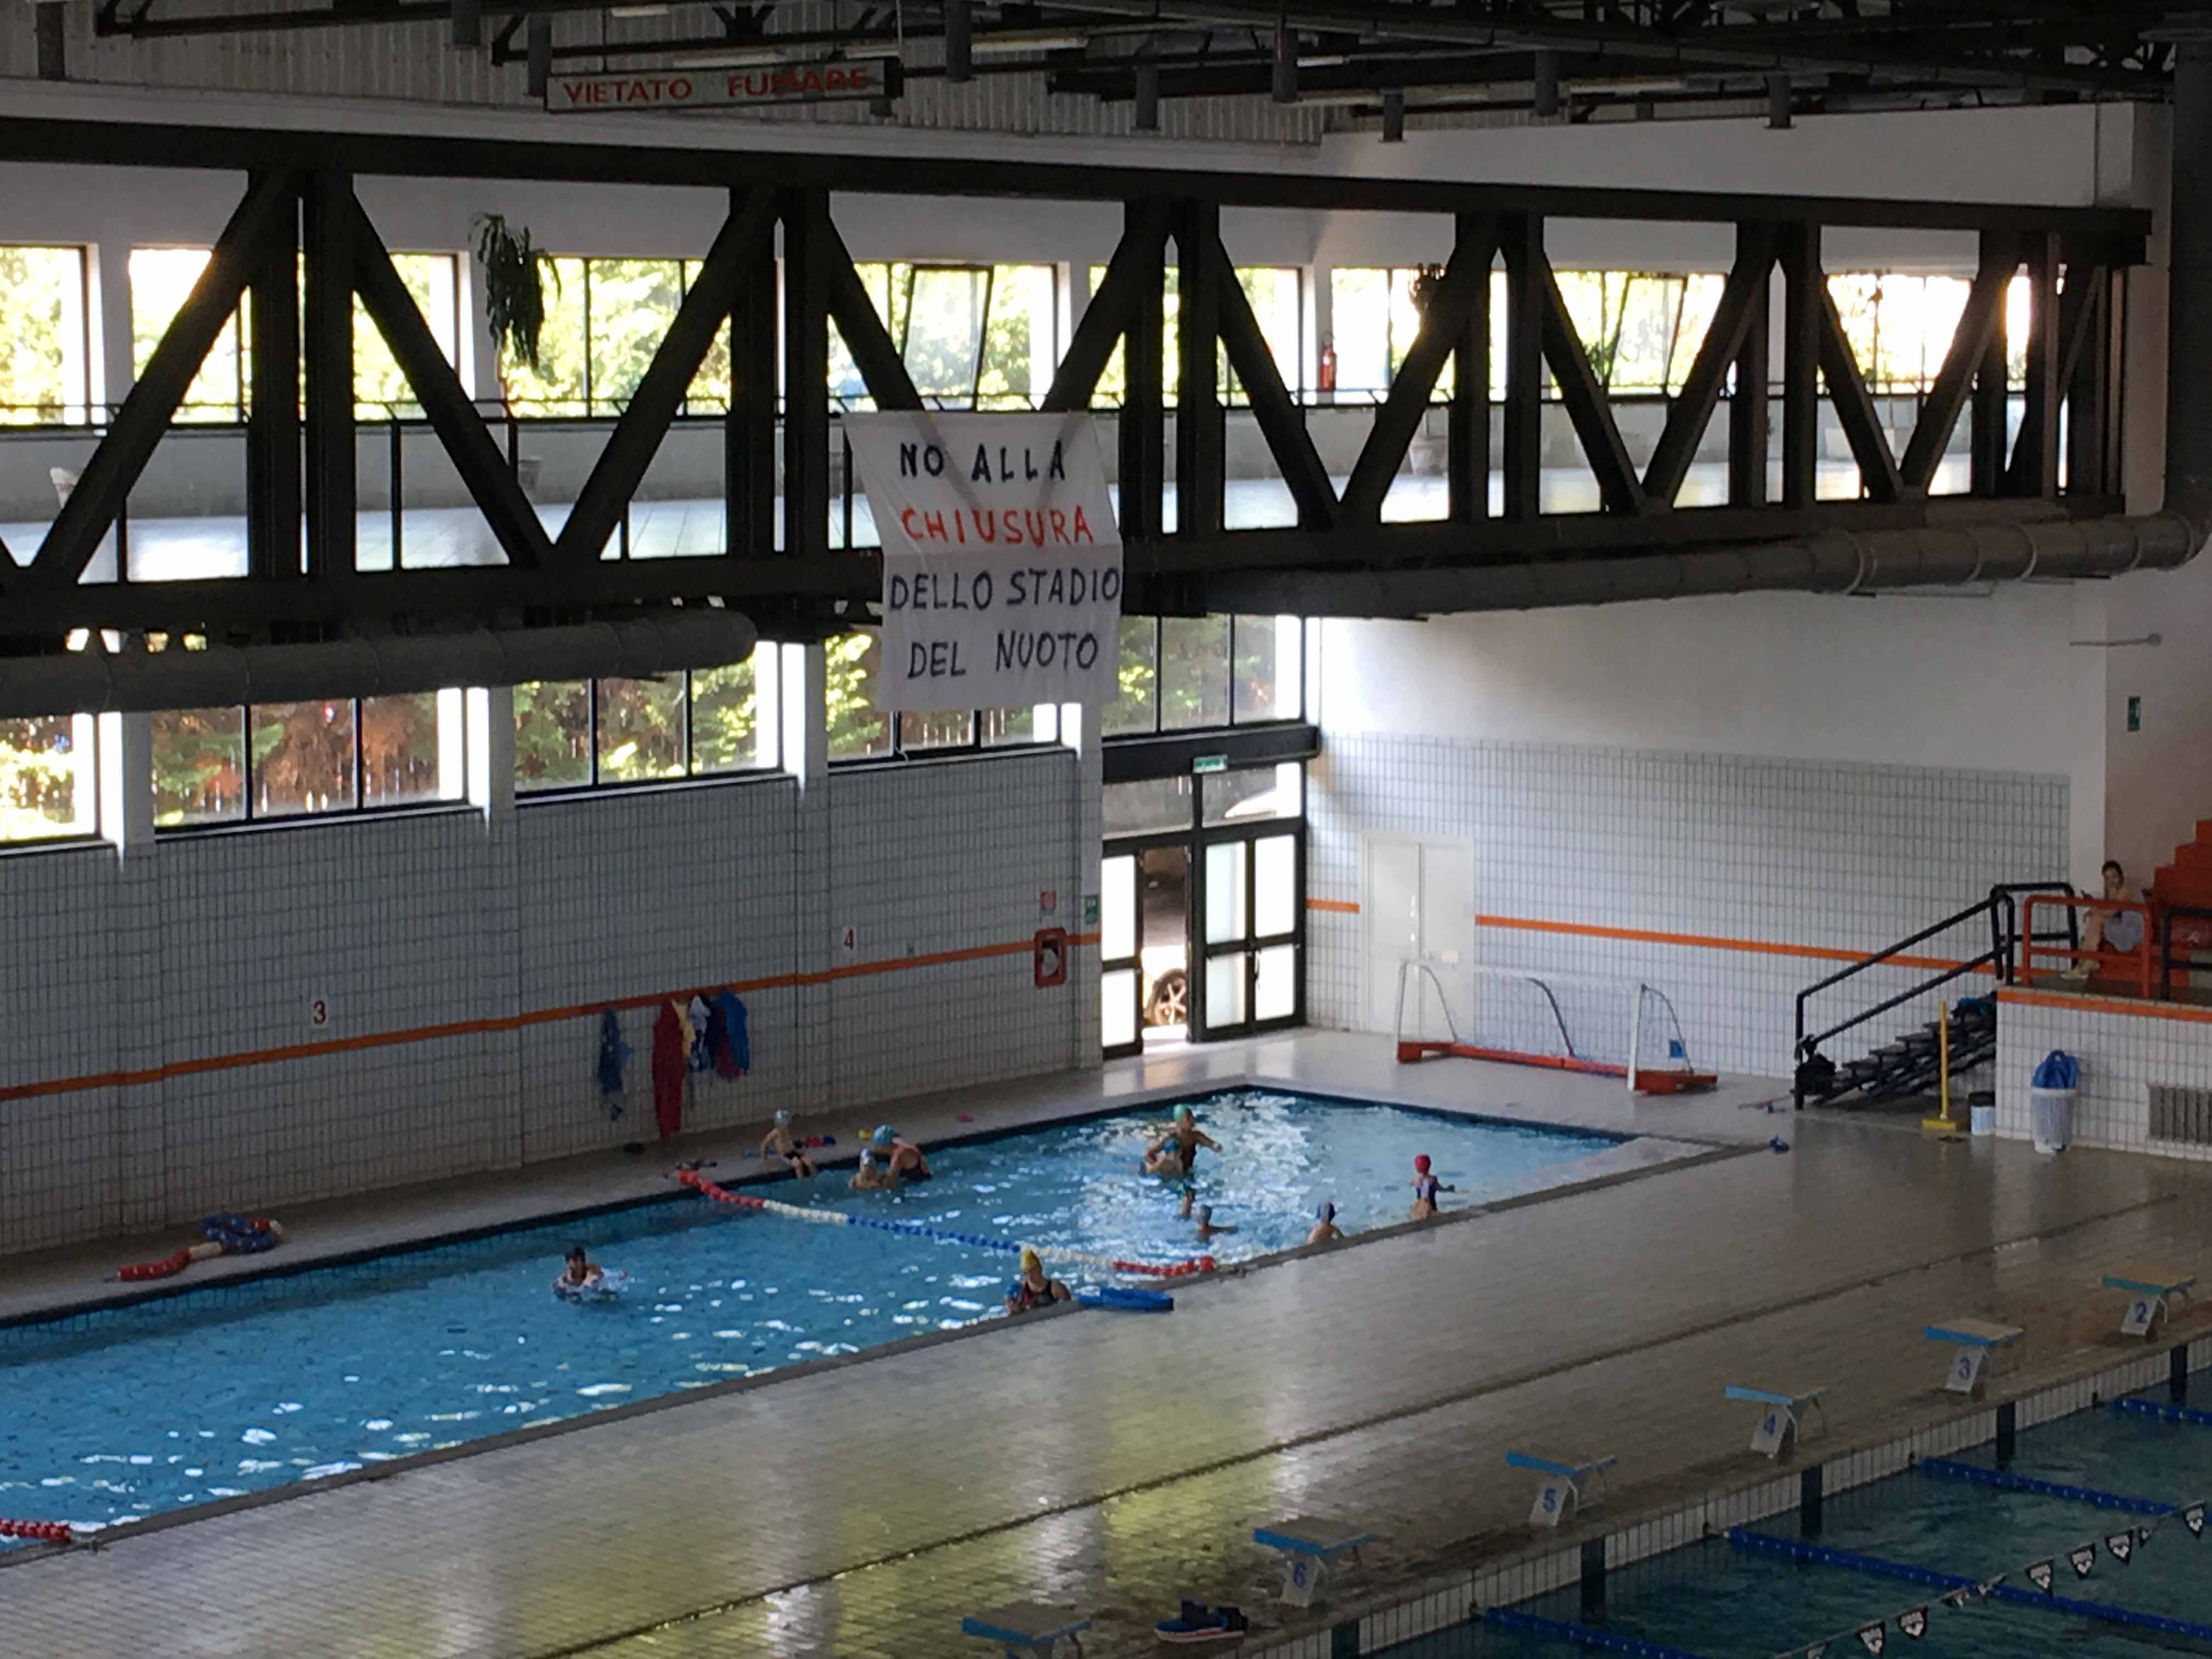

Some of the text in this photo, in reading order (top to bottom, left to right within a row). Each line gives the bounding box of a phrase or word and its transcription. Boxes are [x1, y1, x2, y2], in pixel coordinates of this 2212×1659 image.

[563, 68, 867, 104] VIETATO FUMARE
[900, 439, 1066, 483] NO ALLA
[901, 505, 1093, 546] CHIUSURA
[889, 567, 1120, 611] DELLO STADIO
[907, 629, 1098, 679] DEL NUOTO
[844, 929, 854, 949] 4
[314, 1000, 326, 1024] 3
[2135, 1301, 2147, 1324] 2
[1959, 1356, 1971, 1379] 3
[1763, 1414, 1776, 1436] 4
[1543, 1488, 1556, 1512] 5
[1293, 1562, 1307, 1587] 6
